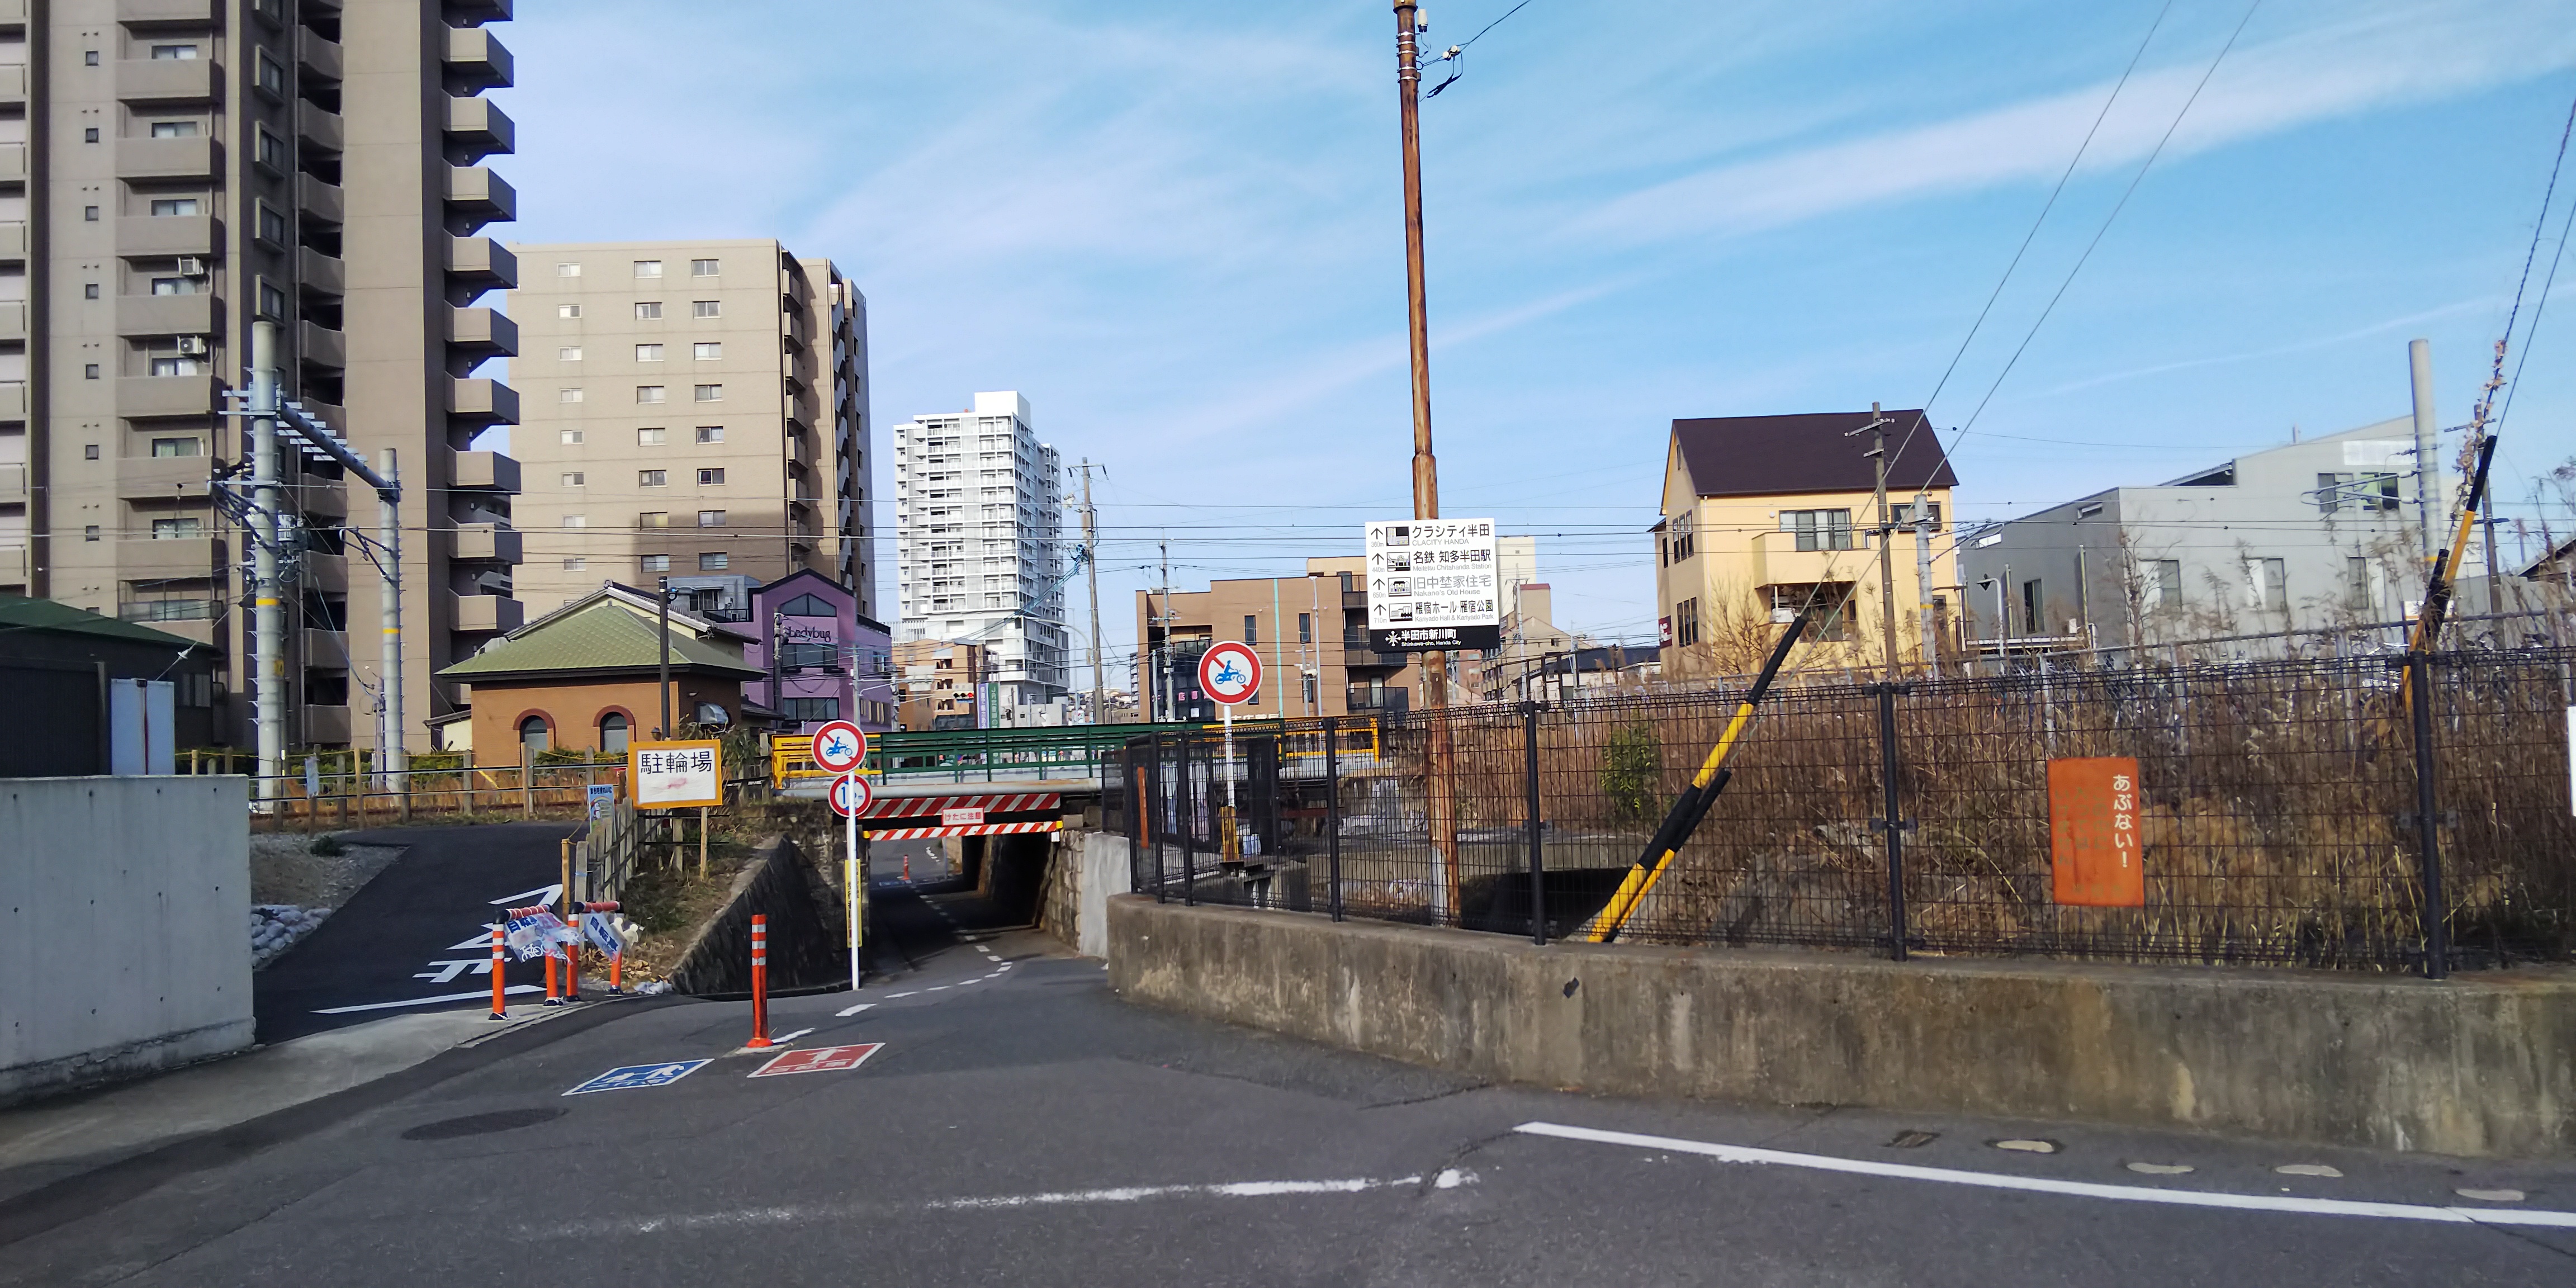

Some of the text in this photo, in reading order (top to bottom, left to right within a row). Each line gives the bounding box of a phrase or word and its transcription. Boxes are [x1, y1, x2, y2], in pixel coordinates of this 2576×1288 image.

[1412, 524, 1489, 538] クラシティ半田
[1413, 549, 1491, 564] 名鉄 知多半田駅
[1414, 574, 1491, 590] 旧中埜家住宅
[788, 626, 831, 642] Ladybug
[1401, 629, 1457, 641] 半田市新川町
[641, 751, 713, 774] 駐輪場
